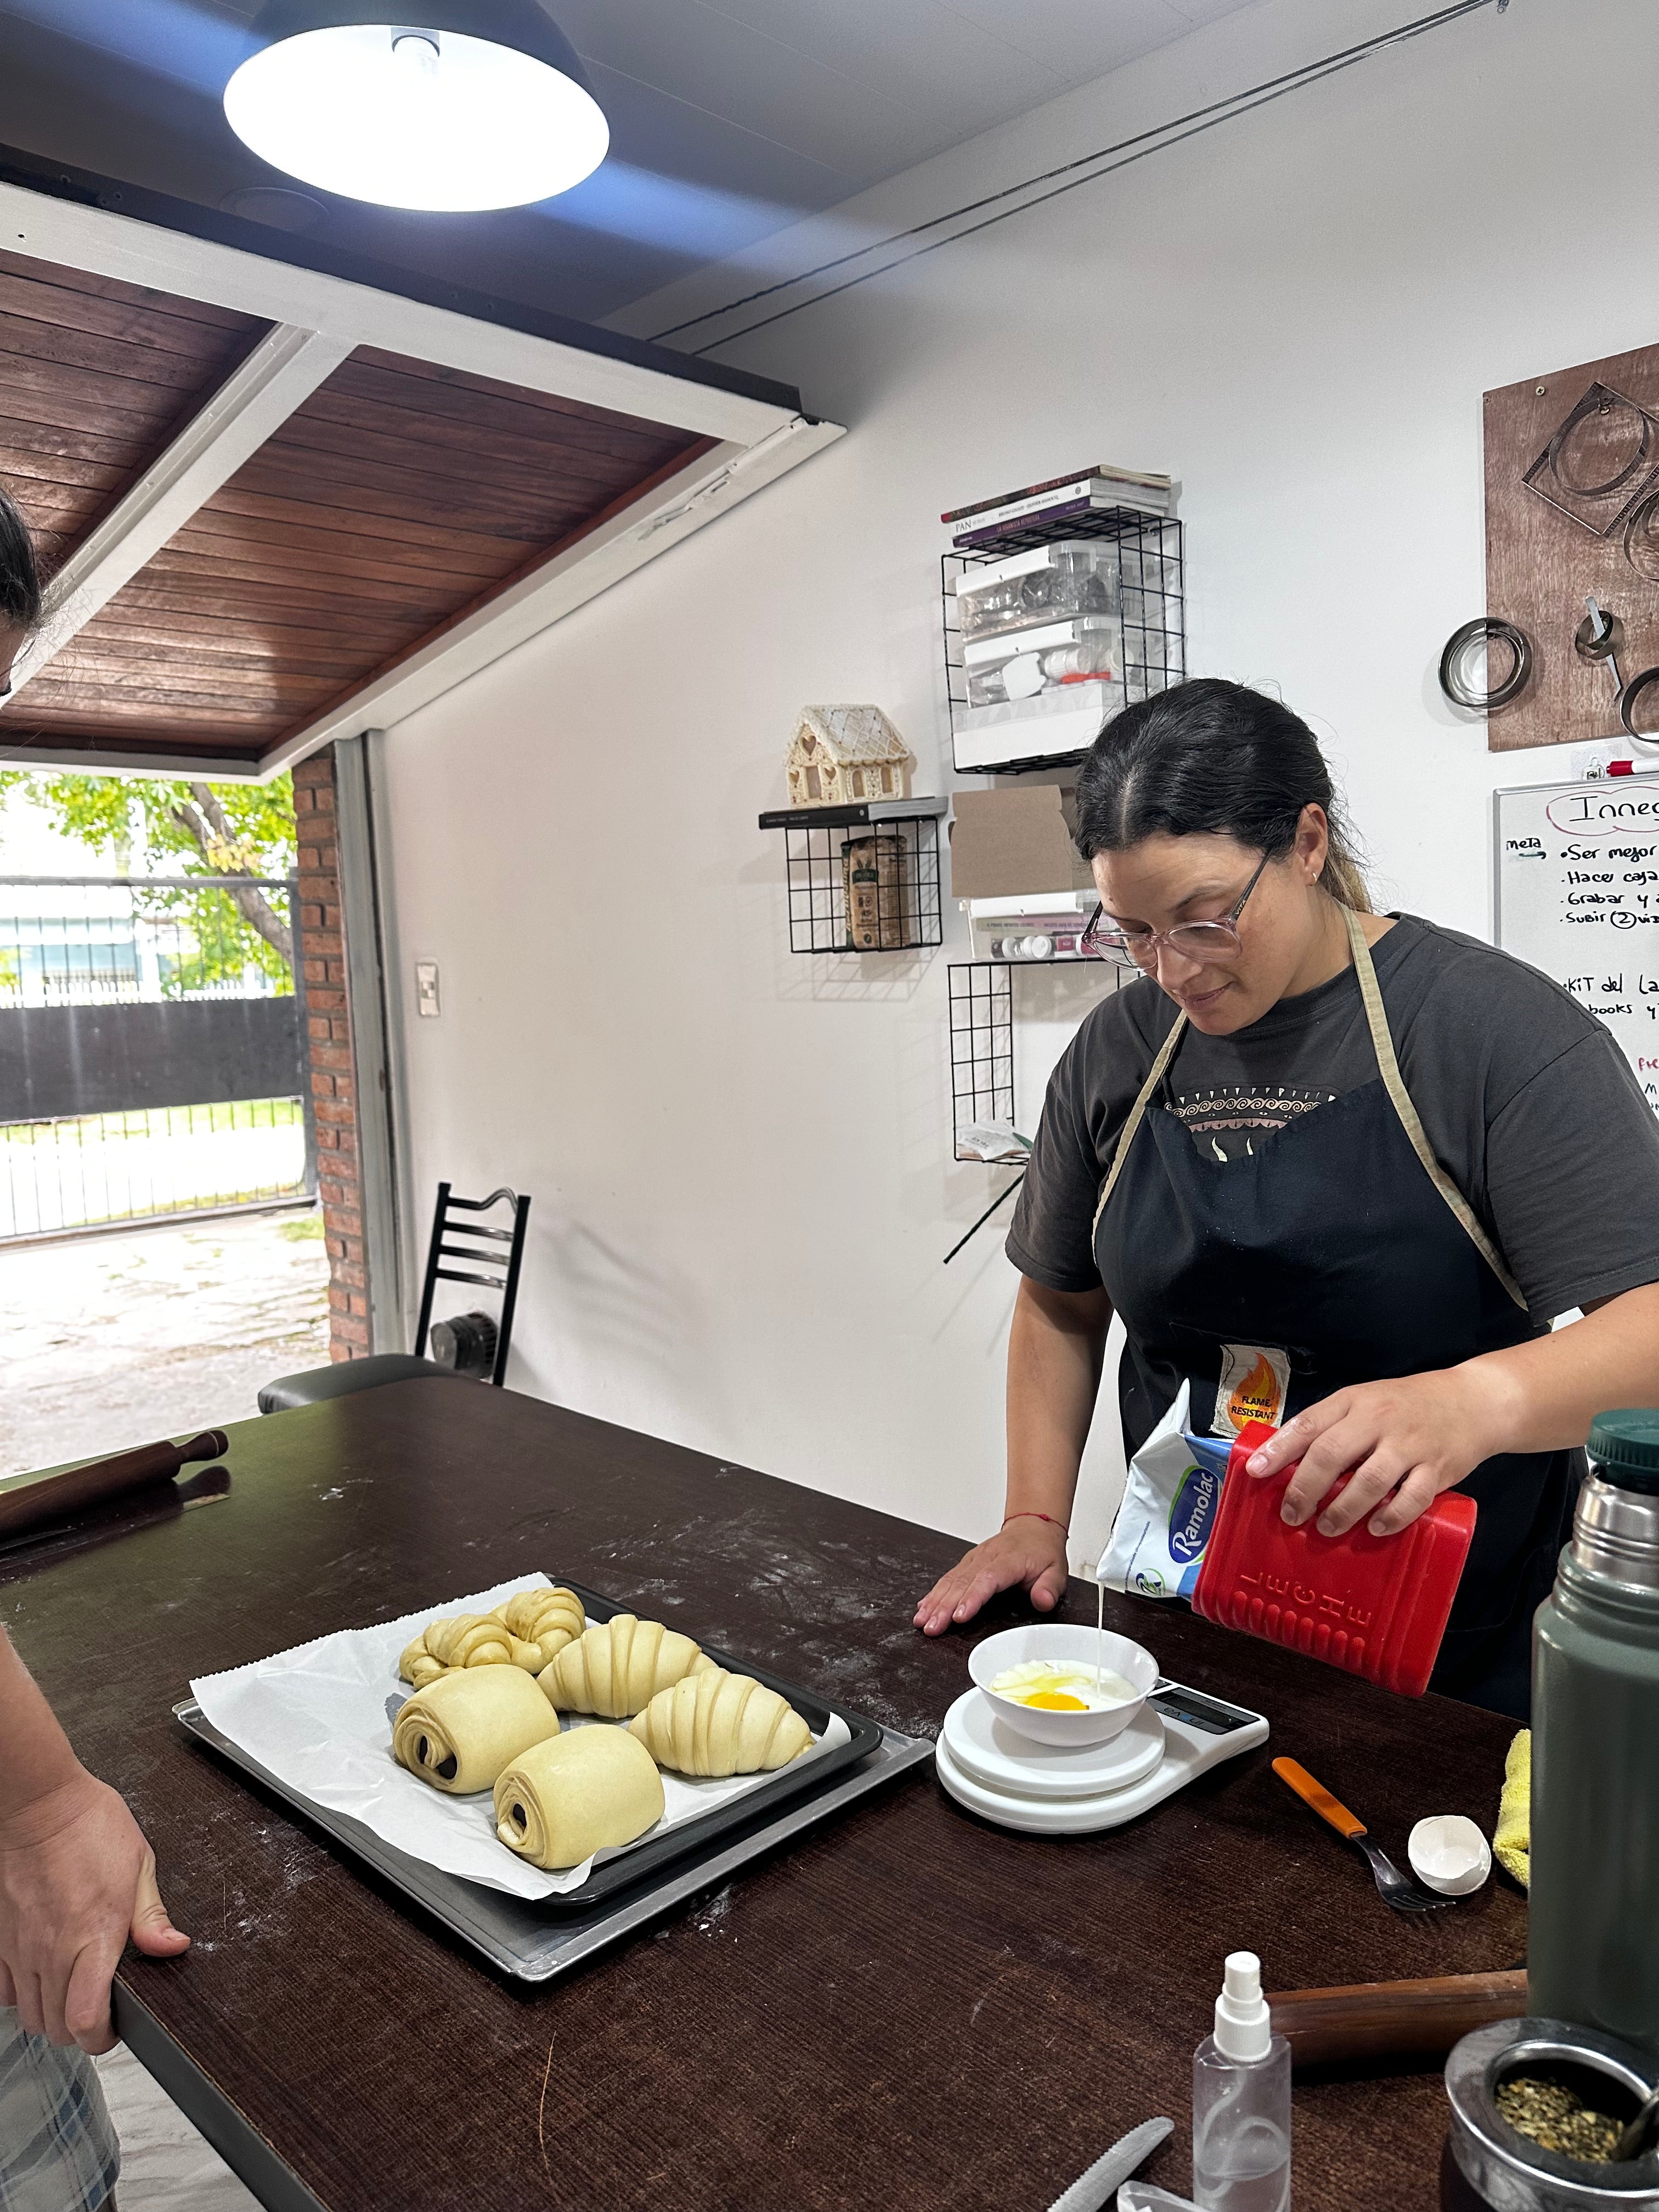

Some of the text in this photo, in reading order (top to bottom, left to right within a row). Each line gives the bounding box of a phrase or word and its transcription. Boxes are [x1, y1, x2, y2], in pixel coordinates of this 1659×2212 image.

[955, 520, 972, 533] PAN
[1567, 844, 1657, 862] Ser mejor
[1567, 871, 1614, 884] Hacer
[1567, 892, 1625, 905] Grabar
[1601, 973, 1622, 994] del
[1242, 1396, 1272, 1407] FLAME
[1231, 1406, 1276, 1419] RESISTANT
[1172, 1472, 1214, 1556] Ramolac
[1240, 1572, 1372, 1627] LECHE
